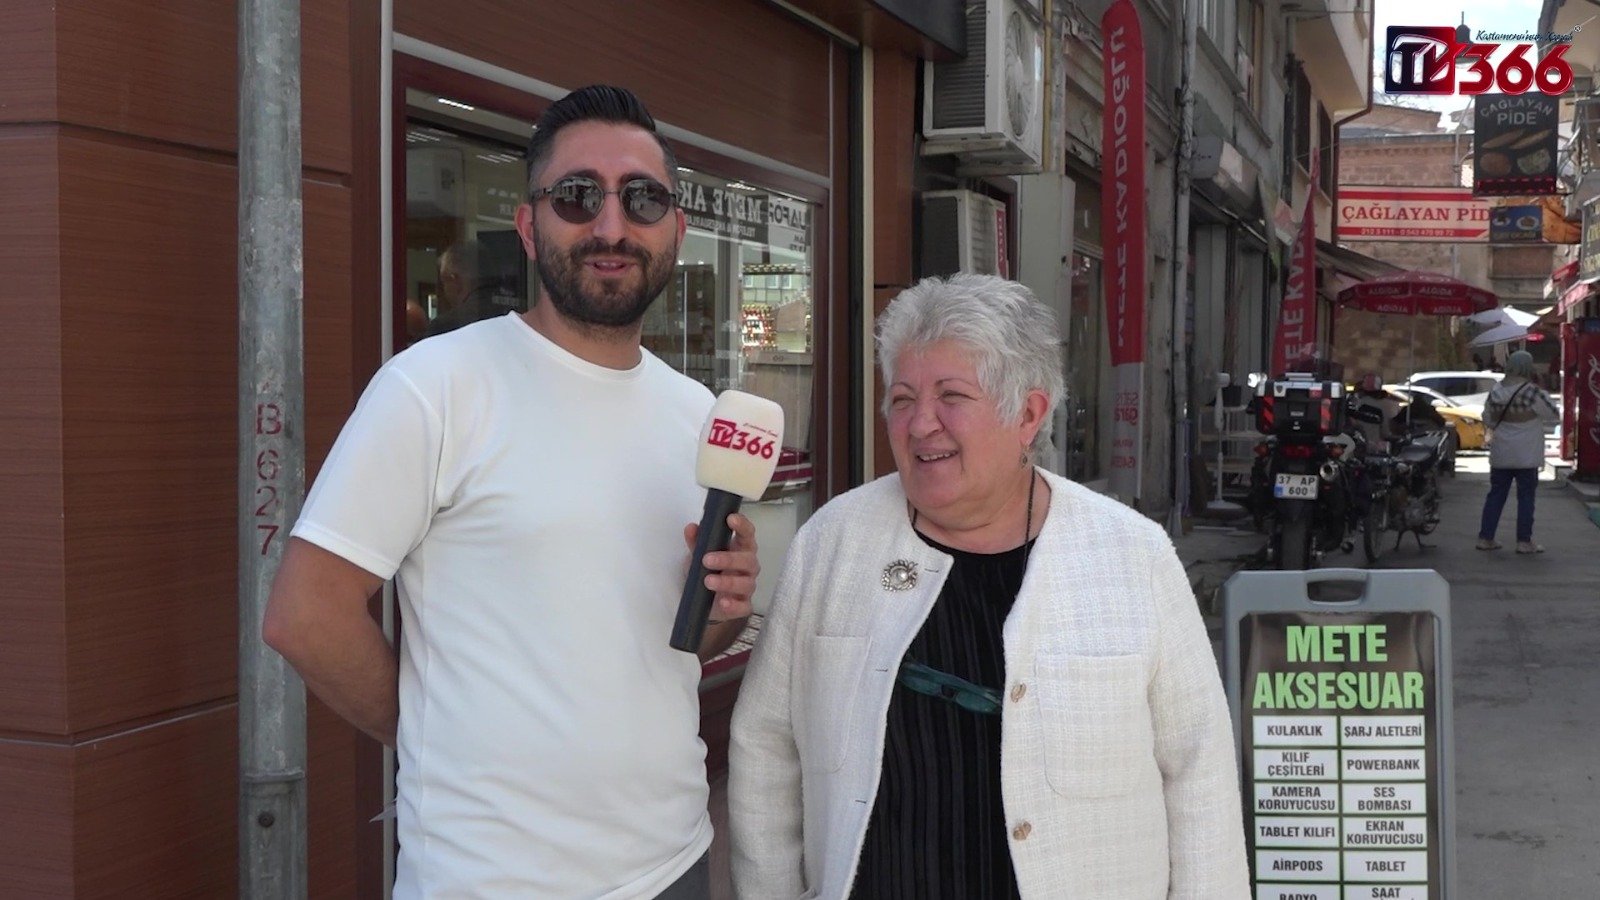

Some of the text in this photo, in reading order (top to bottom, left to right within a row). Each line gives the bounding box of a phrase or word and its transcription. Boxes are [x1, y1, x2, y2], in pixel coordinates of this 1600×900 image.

[1497, 109, 1538, 125] PİDE
[1342, 203, 1490, 223] ÇAĞLAYAN PİD
[1278, 476, 1315, 486] 37 AP
[1288, 486, 1308, 496] 600
[1286, 625, 1388, 662] METE
[1252, 671, 1424, 709] AKSESUAR
[1267, 725, 1323, 737] KULAKLIK
[1344, 723, 1422, 738] ŞARJ ALETLERİ
[1281, 751, 1310, 763] KILIF
[1267, 763, 1325, 777] ÇEŞİTLERİ
[1346, 759, 1420, 771] POWERBANK
[1271, 785, 1322, 798] KAMERA
[1373, 786, 1396, 798] SES
[1257, 798, 1336, 811] KORUYUCUSU
[1357, 799, 1412, 811] BOMBASI
[1259, 825, 1336, 838] TABLET KILIFI
[1365, 820, 1405, 832] EKRAN
[1346, 833, 1424, 845] KORUYUCUSU
[1272, 858, 1324, 872] AİRPODS
[1365, 860, 1406, 872] TABLET
[1371, 887, 1401, 899] SAAT
